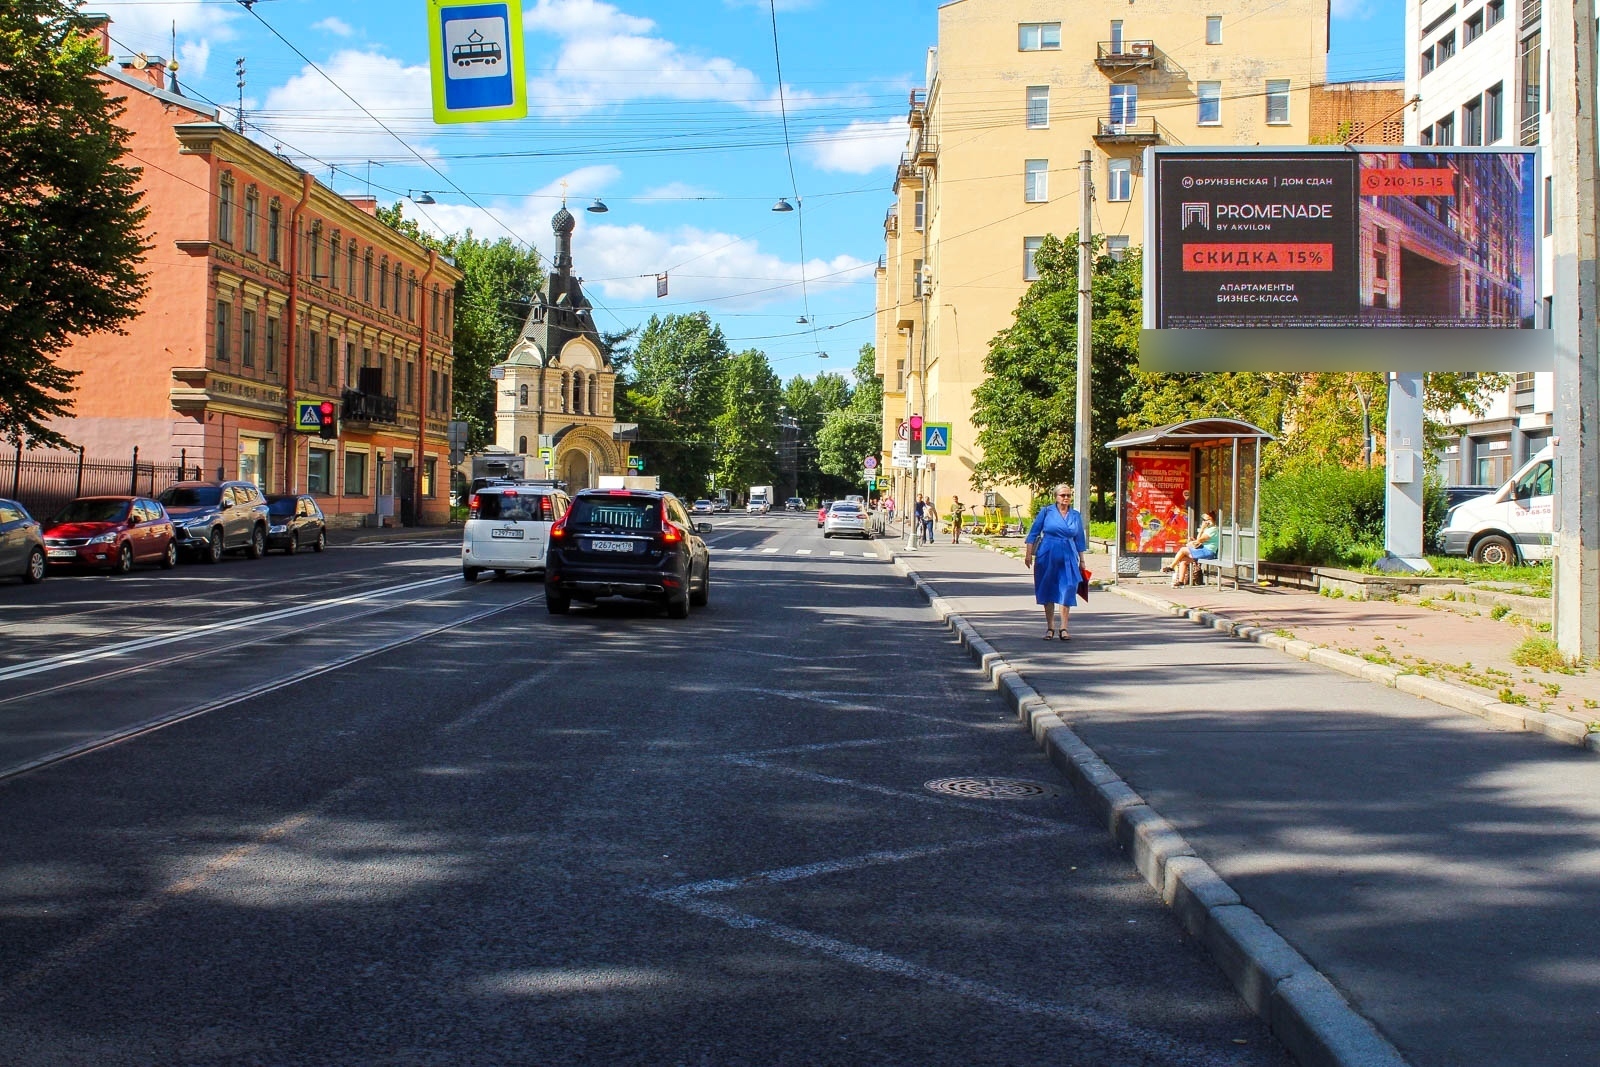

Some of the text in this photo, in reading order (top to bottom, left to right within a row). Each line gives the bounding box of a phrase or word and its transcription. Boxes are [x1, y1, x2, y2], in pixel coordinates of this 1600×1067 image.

[1195, 177, 1268, 186] ФРУНЗЕНСКАЯ
[1280, 178, 1303, 186] ДОМ
[1306, 178, 1333, 186] СДАН
[1384, 177, 1443, 187] 210-15-15
[1216, 204, 1333, 219] PROMENADE
[1192, 251, 1323, 265] СКИДКА 15%
[1219, 283, 1295, 291] АПАРТАМЕНТЫ
[1216, 294, 1299, 303] БИЗНЕС-КЛАССА
